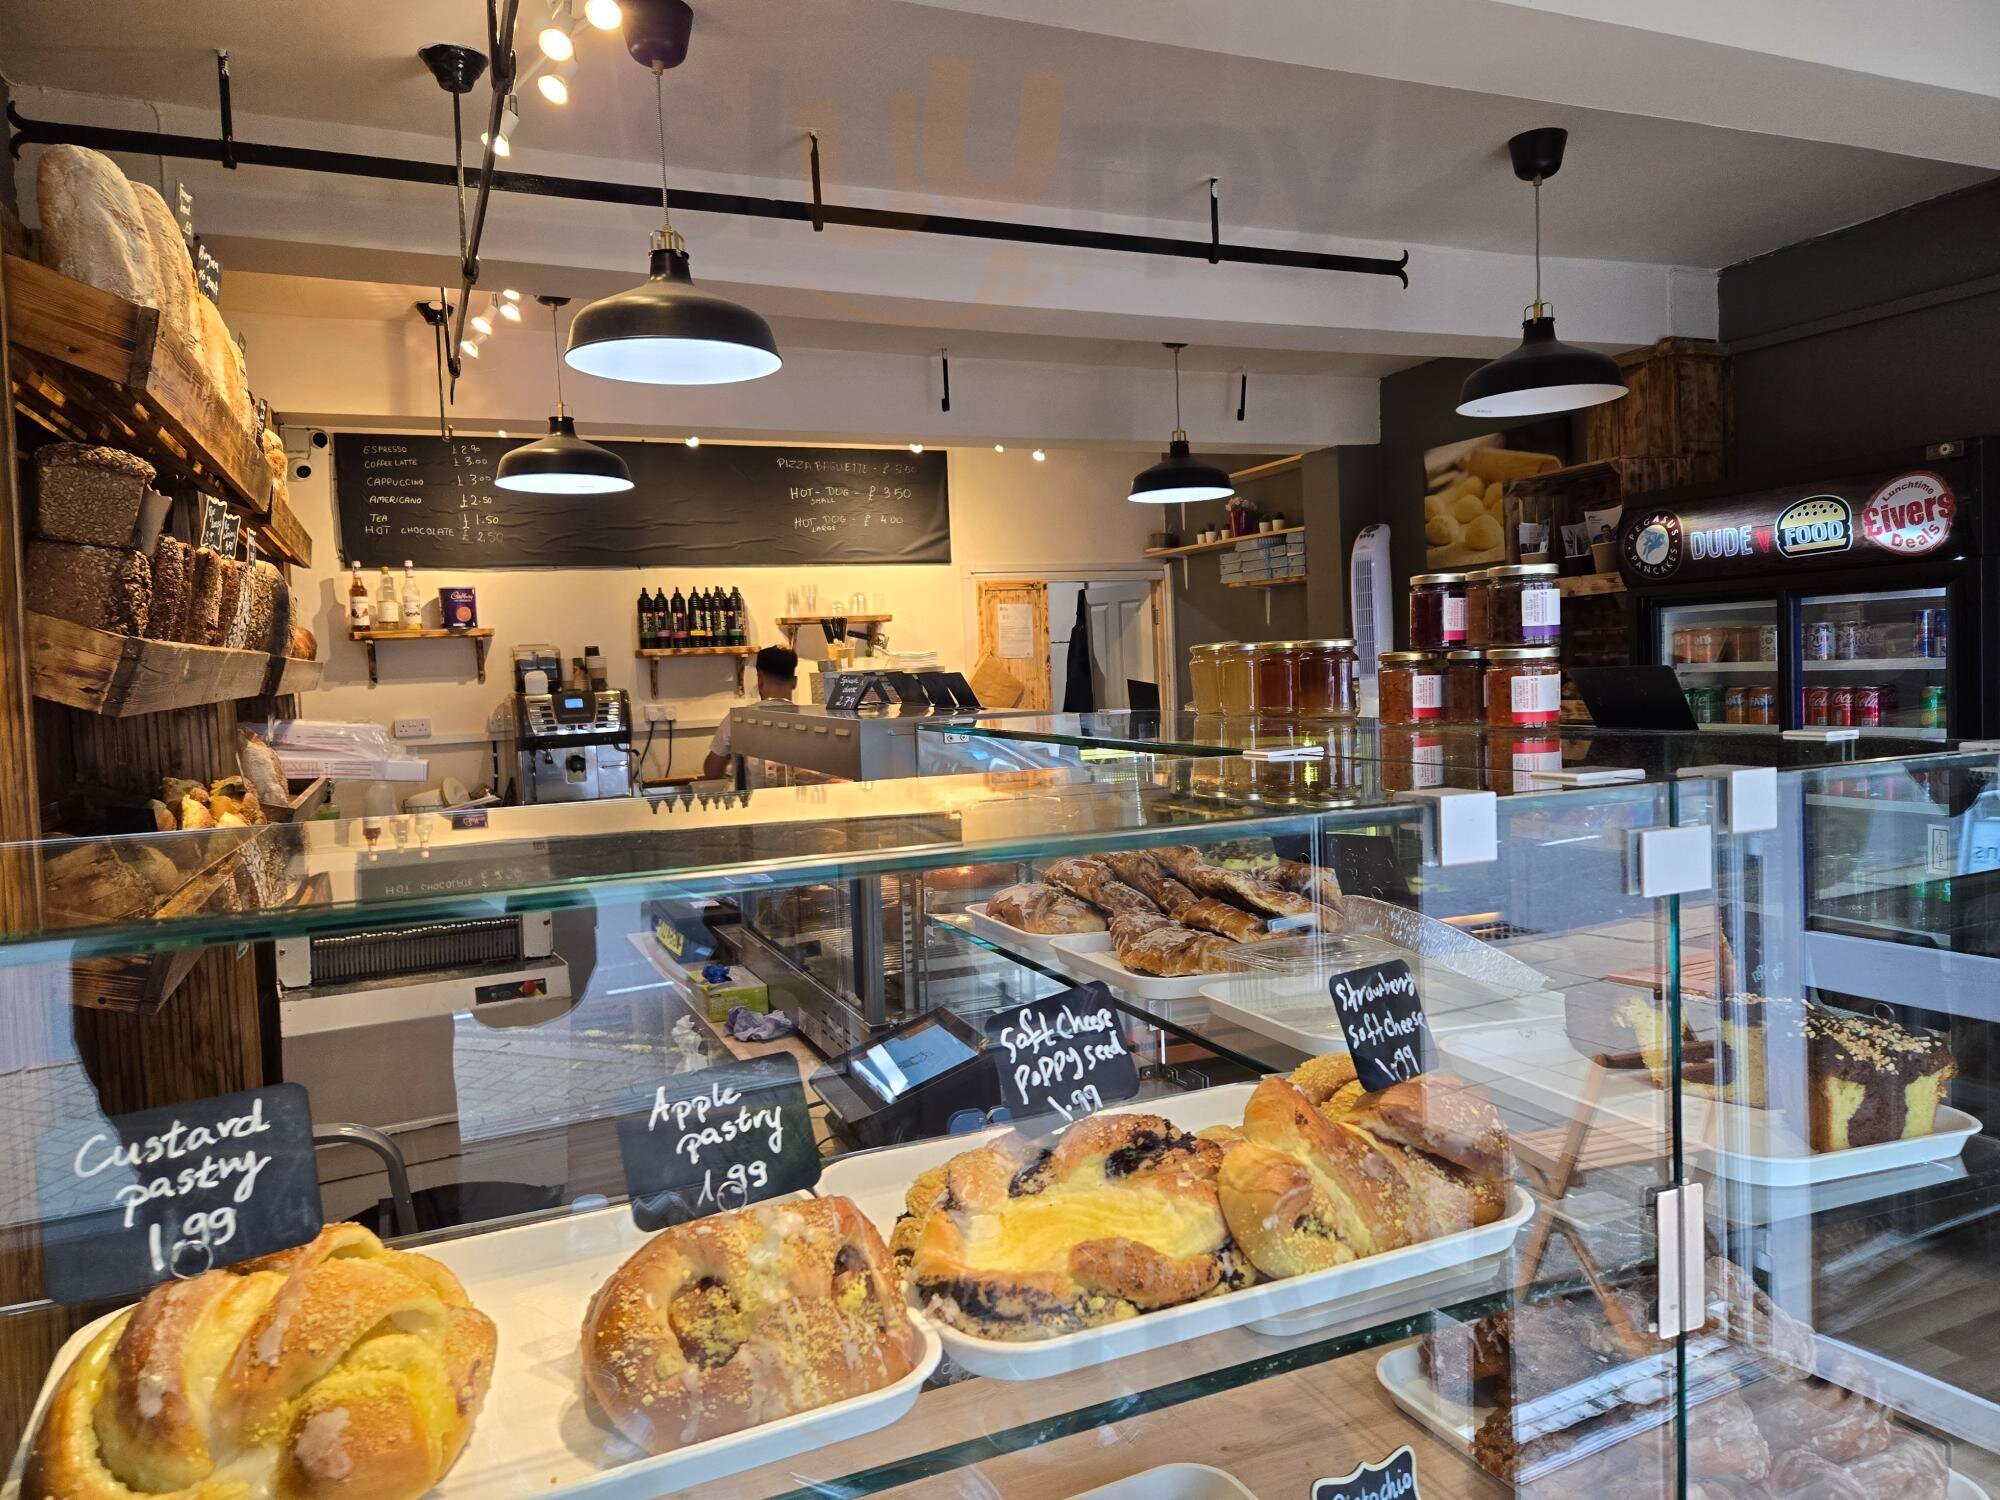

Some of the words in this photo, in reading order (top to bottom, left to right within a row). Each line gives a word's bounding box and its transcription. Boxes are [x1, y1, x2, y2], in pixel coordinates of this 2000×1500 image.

[363, 445, 407, 455] ESPRESSO
[394, 458, 418, 467] LATTE
[776, 457, 811, 471] PIZZA
[366, 477, 424, 487] CAPPUCCINO
[1882, 480, 1935, 502] Lunchtime
[368, 495, 422, 504] AMERICANO
[364, 525, 391, 535] HOT
[401, 526, 455, 536] CHOCOLATE
[794, 516, 817, 529] HOT
[811, 525, 836, 533] LARGE
[1628, 513, 1679, 542] PEGASUS
[1784, 520, 1845, 546] FOOD
[1891, 522, 1941, 548] Deals
[1690, 525, 1753, 560] DUDE
[1630, 547, 1679, 575] PANCAKES
[1335, 972, 1415, 1013] Strawberry
[1374, 1044, 1421, 1082] 1.99
[648, 1082, 742, 1131] Apple
[1047, 1084, 1104, 1122] 1.99
[74, 1098, 272, 1178] Custard
[115, 1150, 273, 1228] pastry
